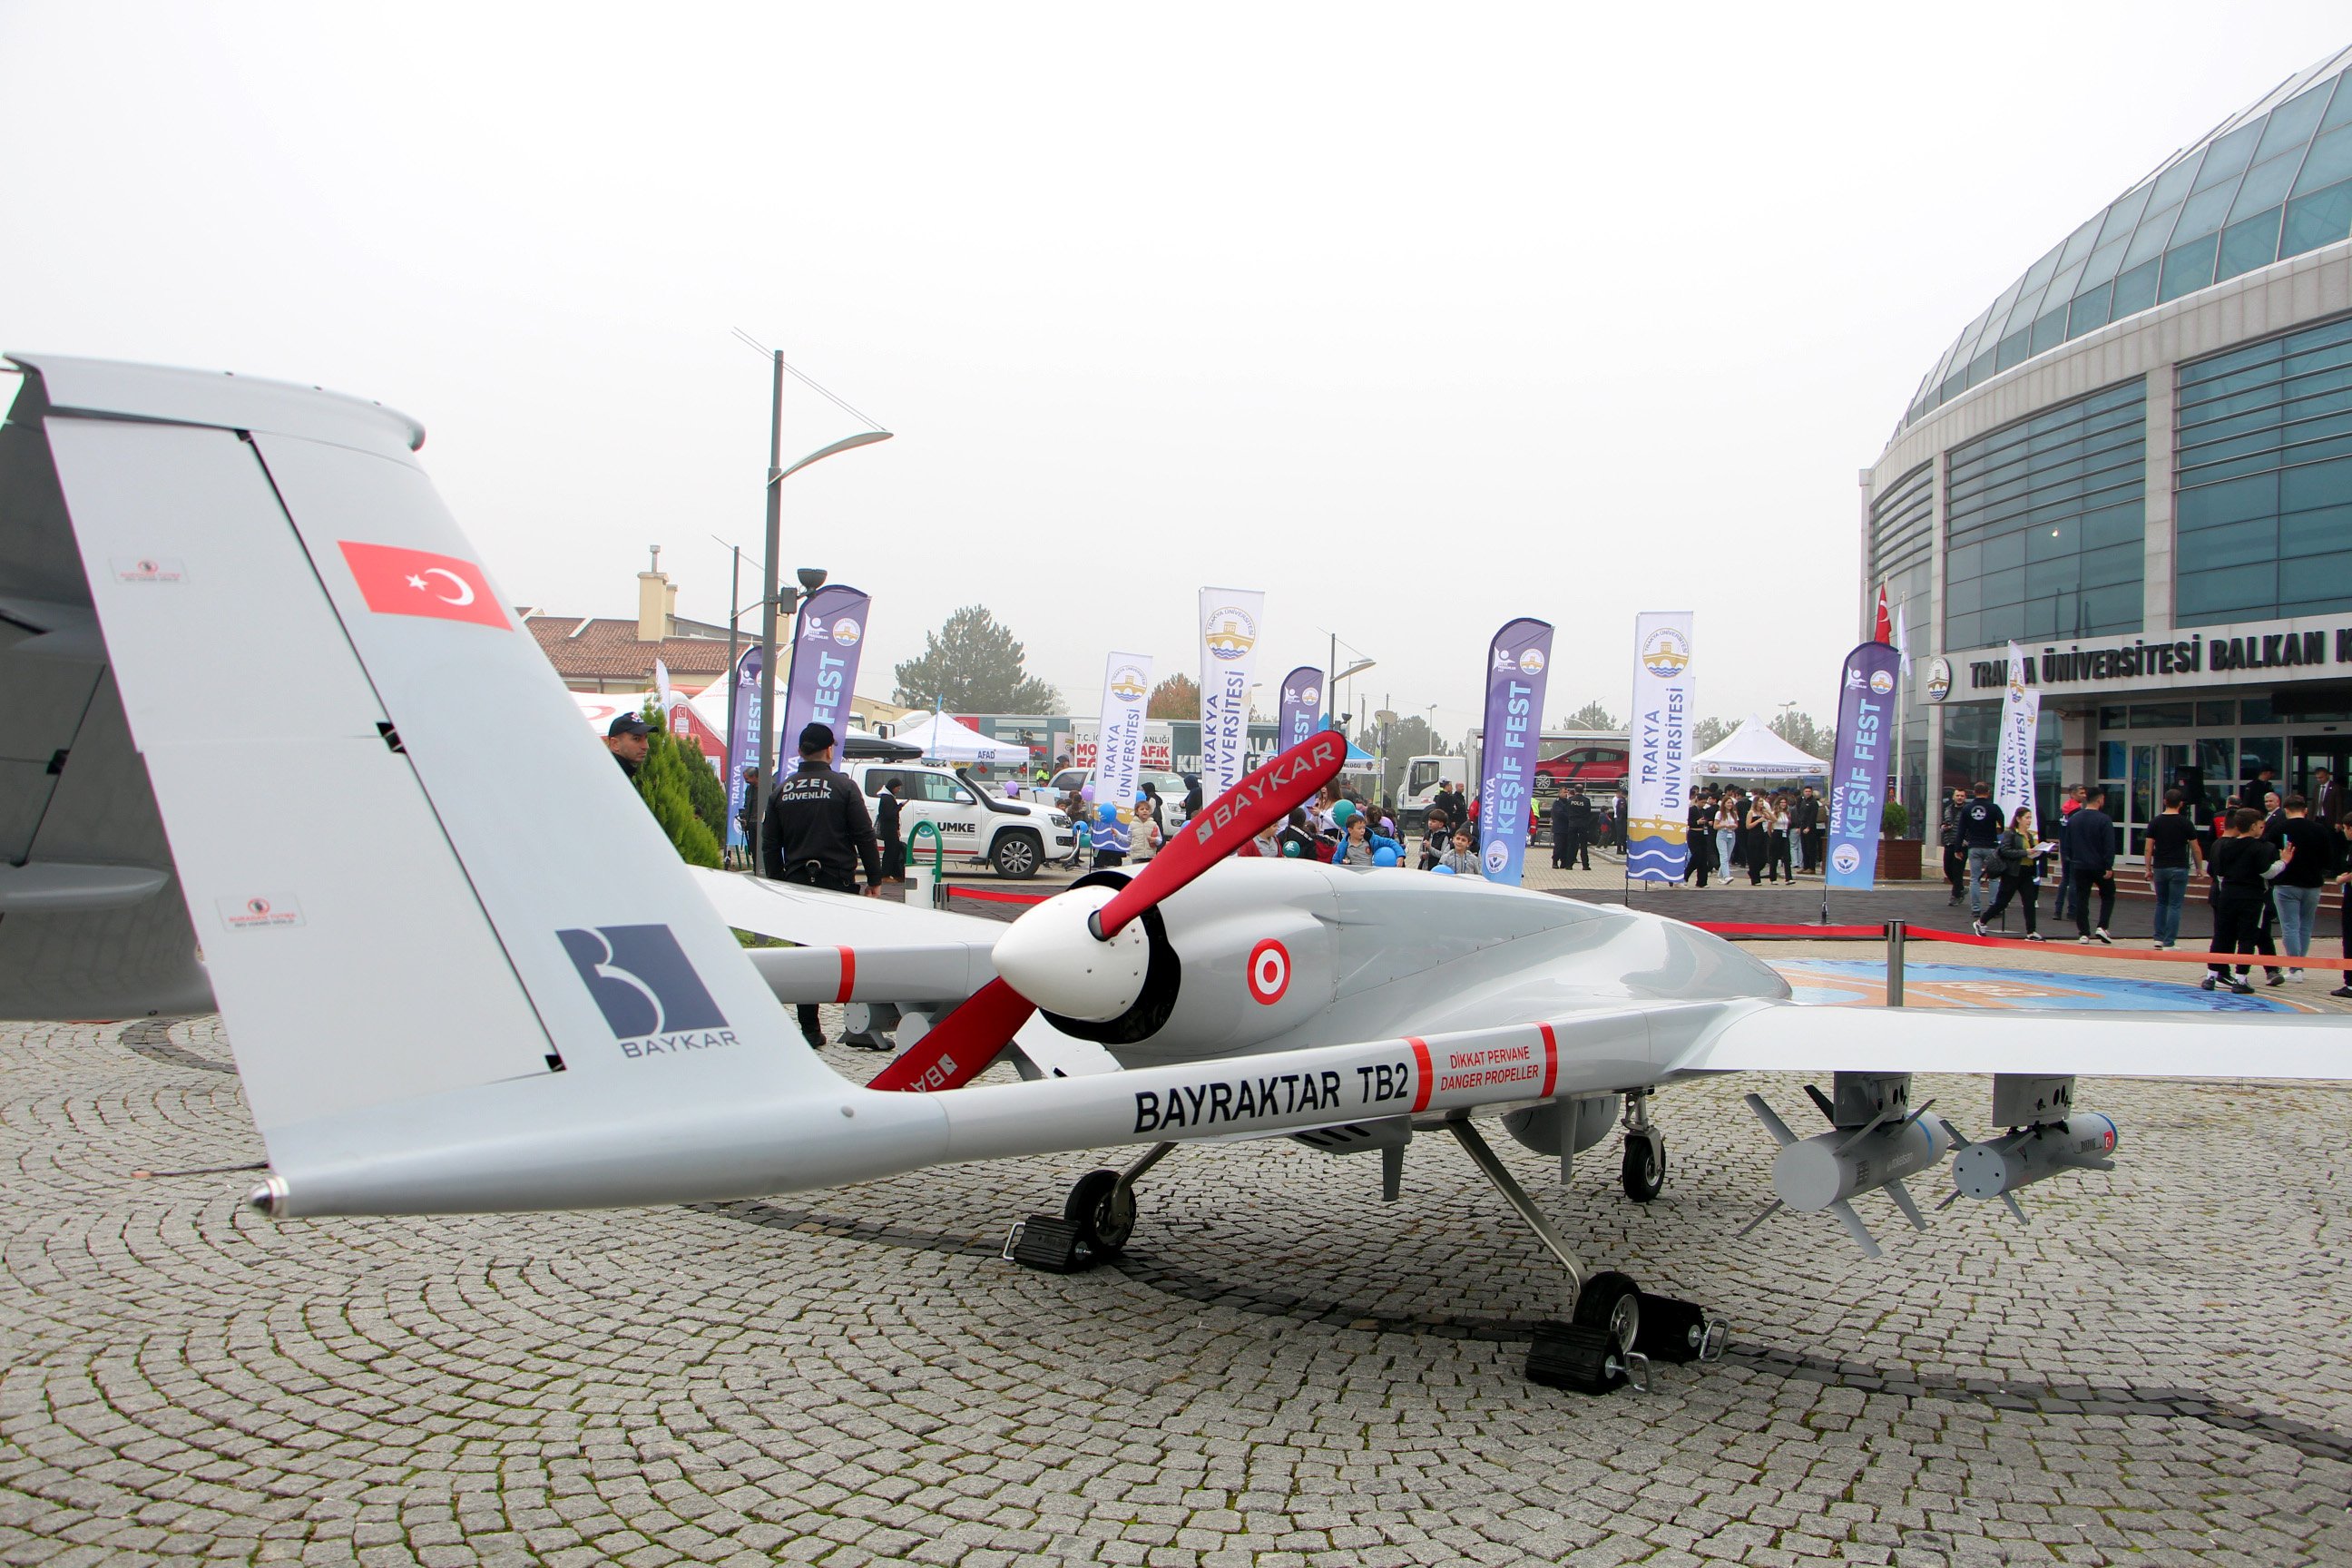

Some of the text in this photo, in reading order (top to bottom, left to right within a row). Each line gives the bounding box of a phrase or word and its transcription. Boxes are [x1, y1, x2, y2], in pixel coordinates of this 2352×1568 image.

[812, 651, 846, 724] FEST
[1970, 657, 2036, 689] TRAA
[2043, 633, 2200, 683] ÜNİVERSİTESİ
[2210, 631, 2325, 671] BALKAN
[1143, 735, 1170, 743] ANLIĞI
[1294, 710, 1310, 745] EST
[1504, 681, 1532, 749] FEST
[1854, 698, 1881, 760] FEST
[977, 750, 995, 760] AFAD
[1103, 724, 1121, 779] TRAKYA
[1116, 709, 1141, 798] ÜNİVERSİTESİ
[1142, 746, 1169, 757] AFİK
[1642, 710, 1661, 785] TRAKYA
[1661, 688, 1684, 808] ÜNİVERSİTESİ
[2014, 711, 2031, 807] NİVERSİTESİ
[731, 764, 741, 806] TRAKYA
[782, 789, 831, 801] GÜVENLİK
[783, 779, 832, 792] ÖZEL
[1213, 741, 1336, 829] BAYKAR
[1496, 756, 1524, 835] KEŞİF
[1830, 786, 1845, 836] TRAKYA
[1845, 767, 1875, 838] KEŞİF
[937, 822, 975, 832] UMKE
[621, 1031, 741, 1059] BAYKAR
[1450, 1046, 1530, 1069] DİKKAT PERVANE
[1133, 1062, 1409, 1133] BAYRAKTAR TB2
[1440, 1064, 1539, 1091] DANGER PROPELLER
